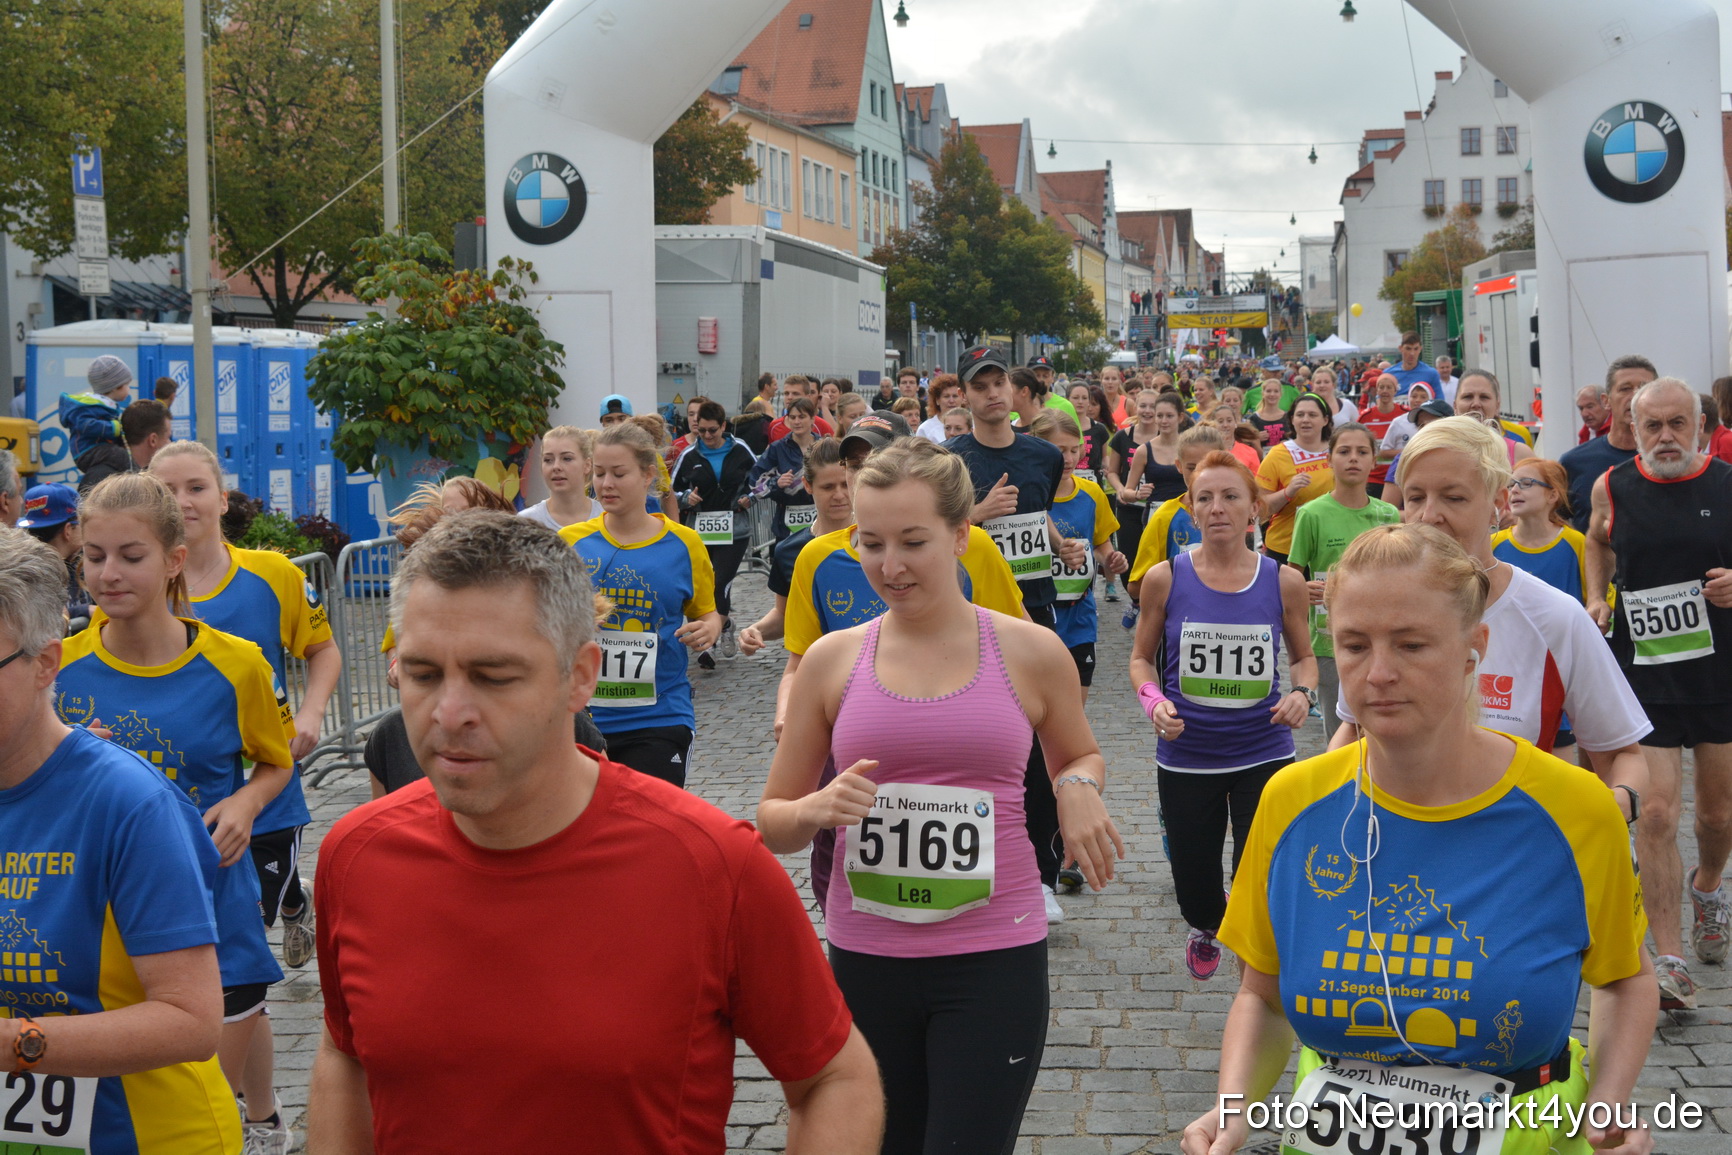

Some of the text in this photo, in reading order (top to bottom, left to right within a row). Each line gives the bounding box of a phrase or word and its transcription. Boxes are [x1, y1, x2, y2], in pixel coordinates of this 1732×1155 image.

[1592, 103, 1677, 139] BMW
[509, 154, 580, 185] BMW
[1200, 315, 1234, 325] START
[16, 321, 25, 342] 3
[218, 366, 237, 392] DIXI
[269, 366, 290, 391] DIXI
[1295, 464, 1319, 474] MAX
[699, 519, 729, 531] 5553
[983, 523, 1007, 531] PARTL
[992, 529, 1046, 556] 5184
[1012, 561, 1041, 573] bastian
[1646, 590, 1687, 604] Neumarkt
[1630, 600, 1700, 637] 5500
[602, 637, 642, 647] Neumarkt
[1183, 630, 1259, 642] PARTL Neumarkt
[601, 649, 649, 679] 117
[1189, 643, 1266, 677] 5113
[595, 685, 637, 697] hristina
[1209, 682, 1241, 696] Heidi
[65, 706, 86, 715] Jahre
[898, 797, 969, 815] Neumarkt
[859, 816, 980, 872] 5169
[1326, 854, 1340, 865] 15
[1314, 866, 1346, 882] Jahre
[897, 882, 932, 904] Lea
[1318, 979, 1471, 1002] 21.September 2014
[1319, 1064, 1471, 1105] PARTL Neumarkt
